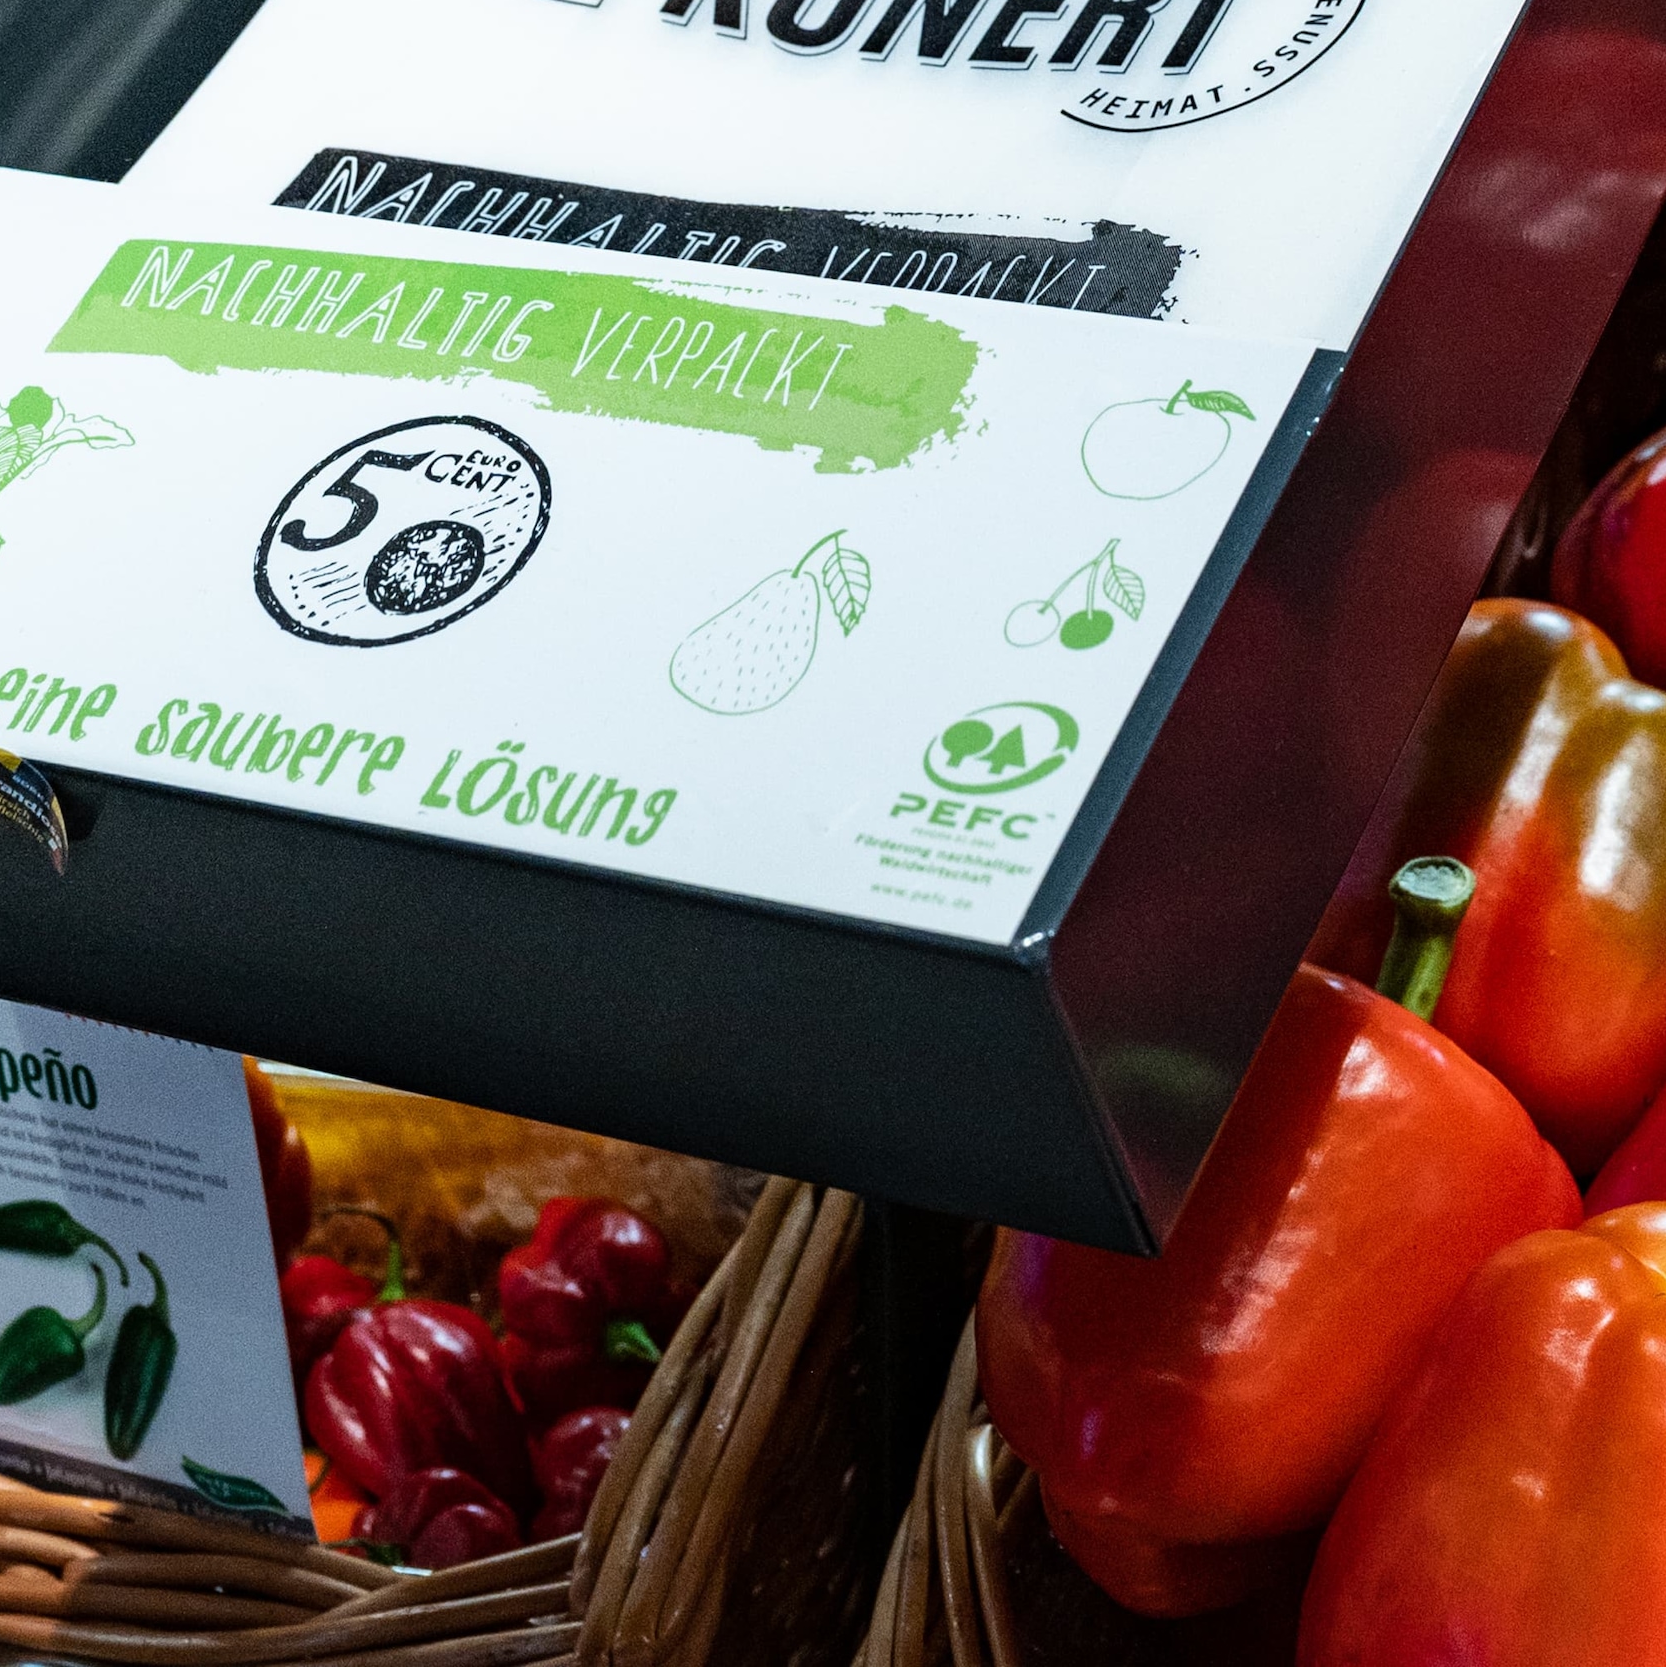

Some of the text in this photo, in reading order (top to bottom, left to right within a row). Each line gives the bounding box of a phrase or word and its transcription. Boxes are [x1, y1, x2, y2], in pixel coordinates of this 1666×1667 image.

[120, 245, 855, 412] NACHHALTIG VERPACKT
[279, 449, 437, 552] 5
[424, 453, 518, 493] CENT
[134, 698, 406, 796] saubere
[889, 792, 1039, 840] PEFC
